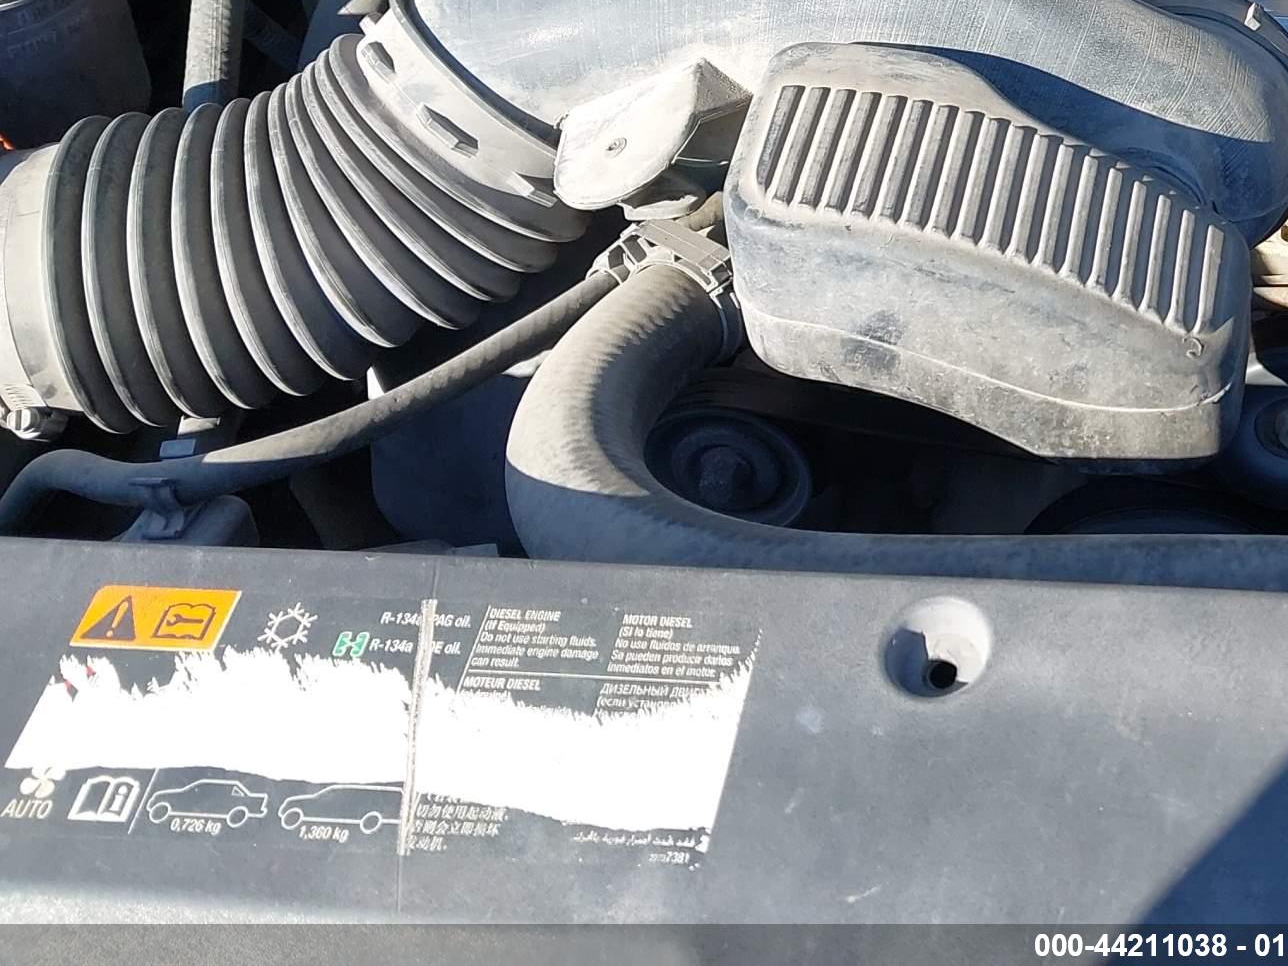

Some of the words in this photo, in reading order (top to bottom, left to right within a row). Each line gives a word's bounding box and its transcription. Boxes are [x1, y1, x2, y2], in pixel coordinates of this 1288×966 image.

[454, 615, 471, 628] oil.
[489, 608, 522, 620] DIESEL
[525, 610, 562, 622] ENGINE
[622, 614, 658, 626] MOTOR
[659, 616, 693, 628] DIESEL
[498, 620, 546, 634] Equipped)
[368, 638, 414, 654] R-134a
[444, 641, 461, 655] oil.
[480, 632, 493, 642] Do
[495, 633, 511, 644] not
[512, 634, 530, 645] use
[531, 635, 567, 649] starting
[569, 636, 597, 647] fluids.
[614, 638, 629, 649] No
[630, 640, 648, 650] use
[649, 639, 681, 652] fluidos
[682, 642, 696, 652] de
[475, 643, 526, 656] Immediate
[526, 646, 559, 659] engine
[560, 647, 599, 661] damage
[624, 651, 661, 664] pueden
[470, 656, 489, 667] can
[490, 657, 520, 668] result.
[660, 665, 674, 675] en
[675, 666, 685, 676] el
[463, 675, 505, 690] MOTEUR
[506, 678, 541, 692] DIESEL
[600, 682, 669, 697] ДИЗЕЛЬНЫЙ
[2, 800, 53, 819] AUTO
[204, 820, 222, 835] kg
[332, 828, 350, 843] kg
